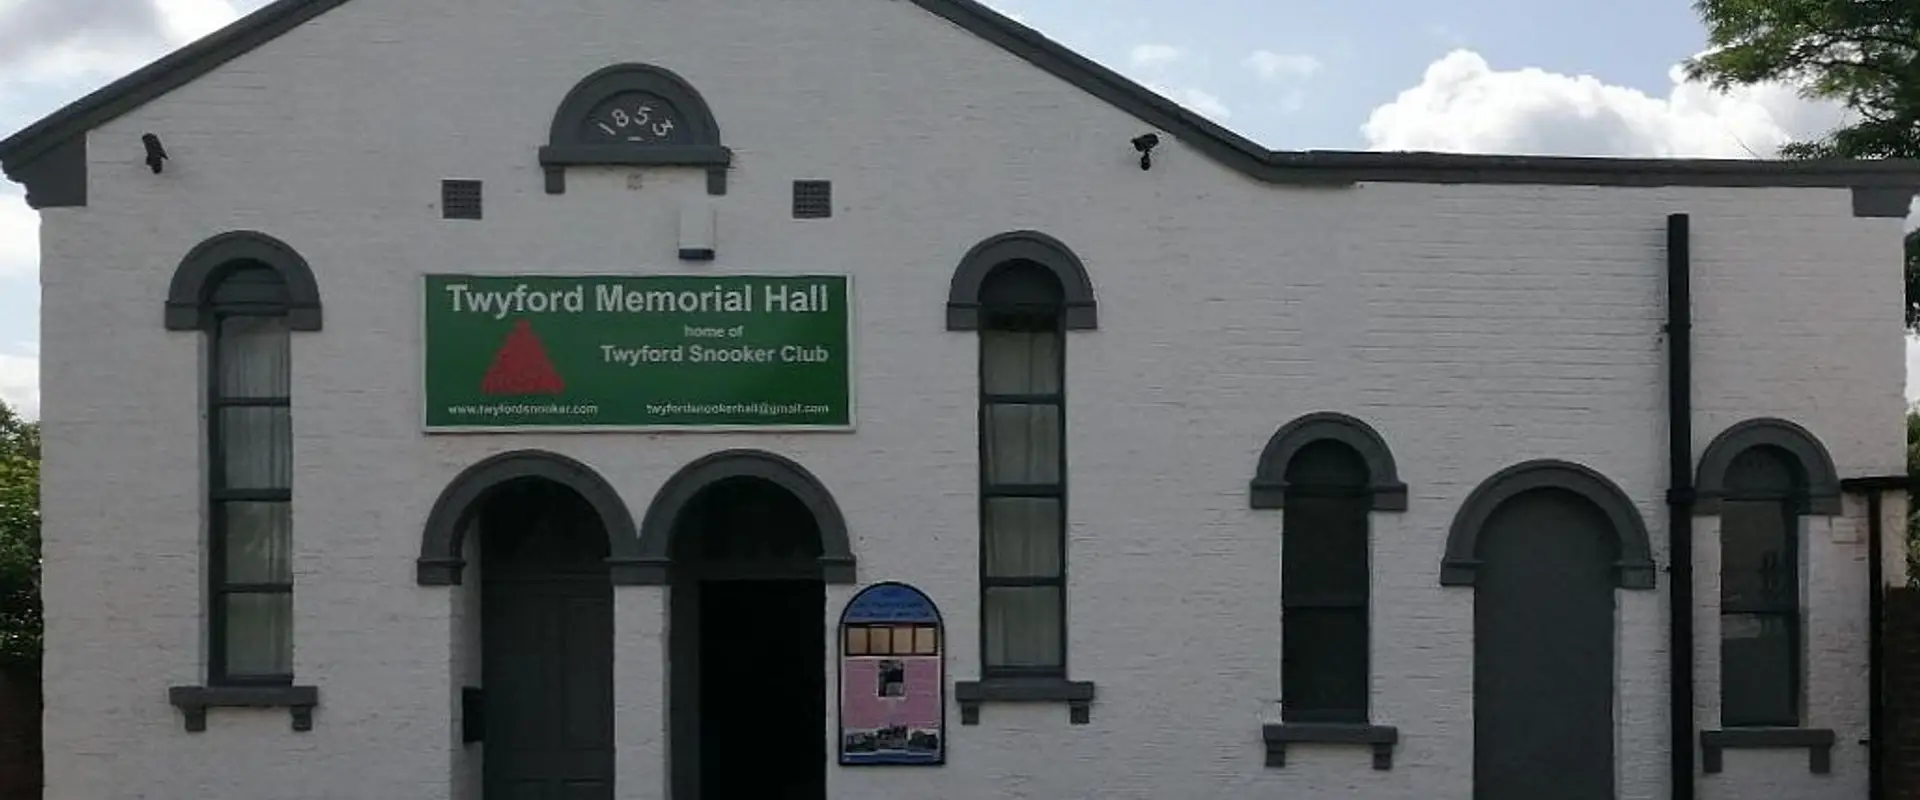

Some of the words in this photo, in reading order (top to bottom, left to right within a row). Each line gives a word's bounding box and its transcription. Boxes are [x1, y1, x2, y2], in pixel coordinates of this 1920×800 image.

[598, 106, 674, 137] 1853
[446, 284, 584, 320] Twyford
[595, 284, 752, 312] Memorial
[764, 284, 828, 312] Hall
[684, 324, 724, 338] home
[727, 324, 744, 338] of
[600, 344, 684, 366] Twyford
[688, 344, 776, 362] Snooker
[780, 344, 829, 362] Club
